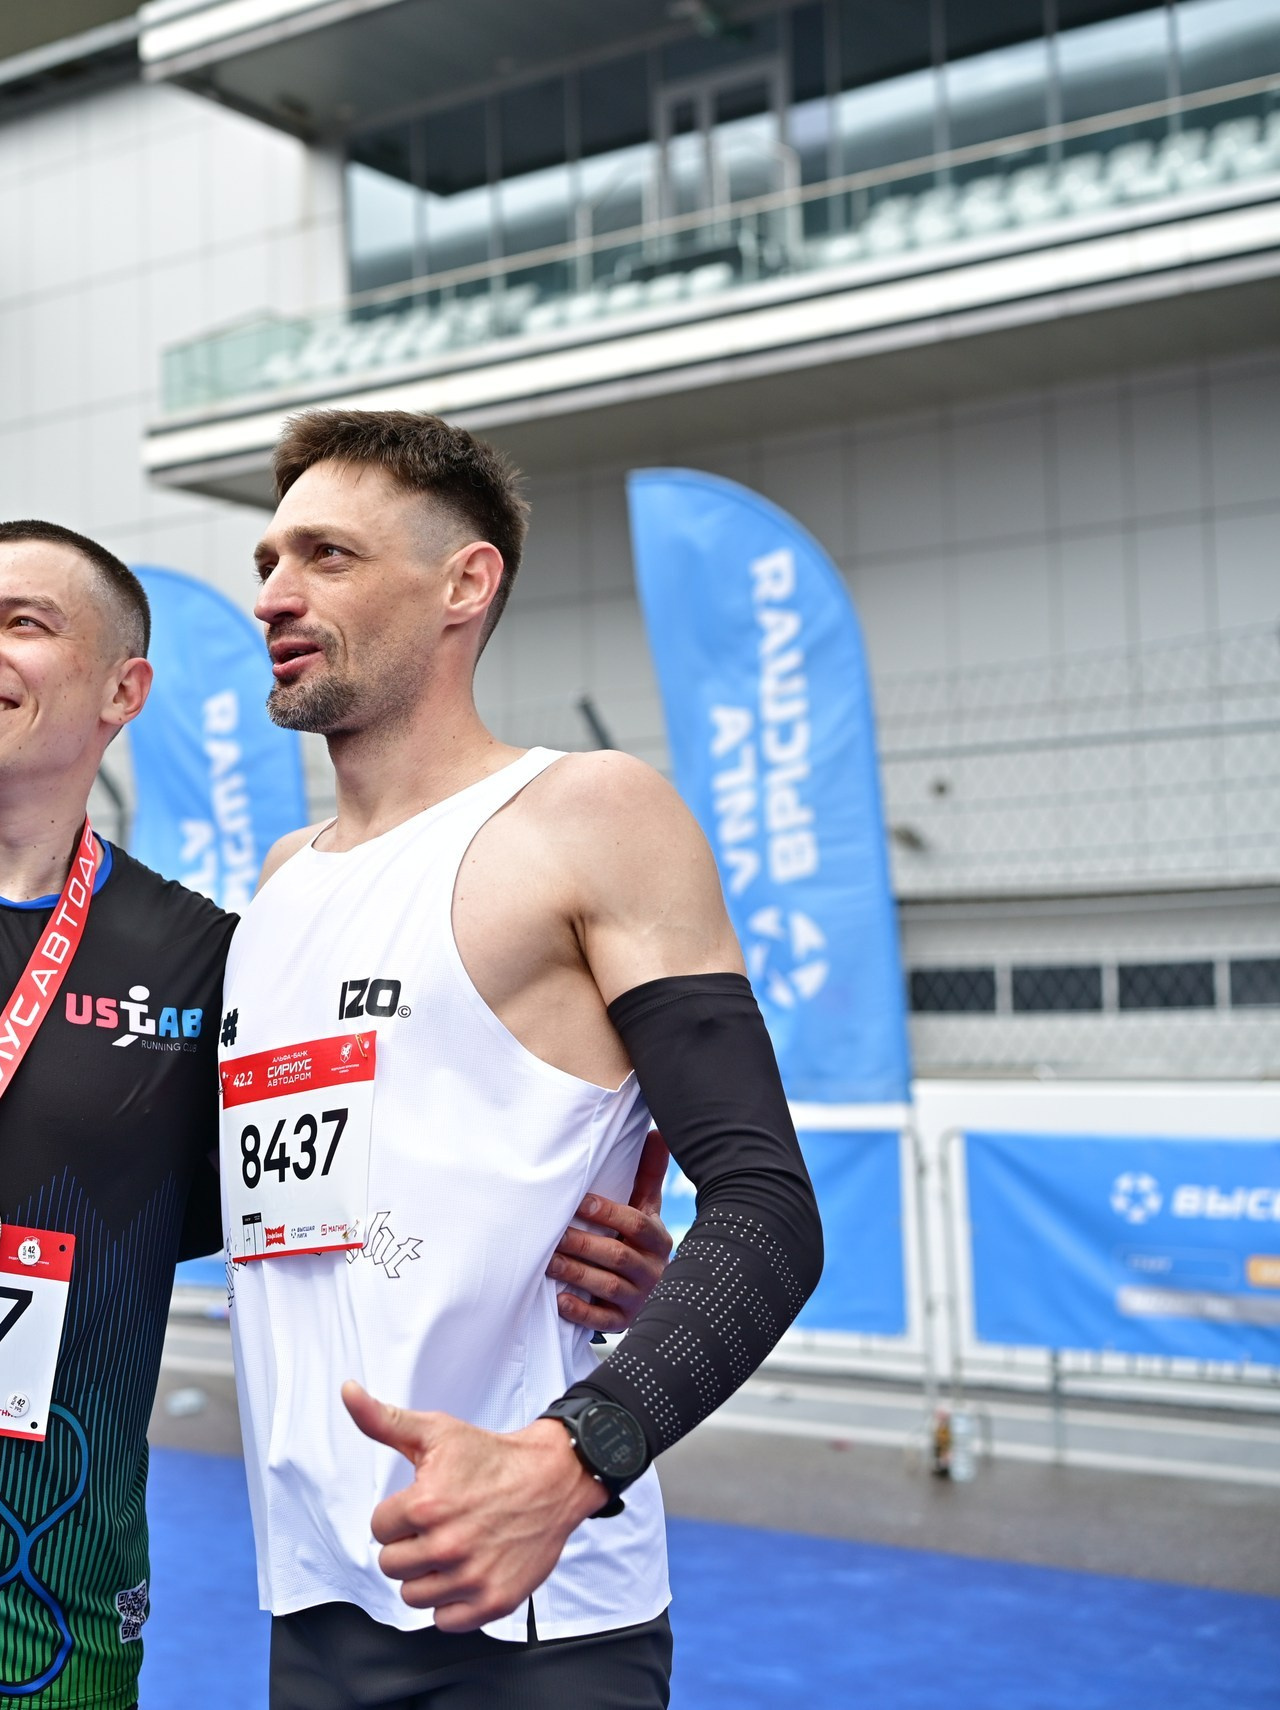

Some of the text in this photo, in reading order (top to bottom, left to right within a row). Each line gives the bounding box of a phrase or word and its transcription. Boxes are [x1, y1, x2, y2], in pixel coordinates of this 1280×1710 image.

[141, 1040, 181, 1052] RUNNING
[272, 1050, 309, 1063] АЛЬФА-БАНК
[267, 1058, 312, 1079] СИРИУС
[233, 1071, 253, 1088] 42.2
[267, 1072, 312, 1088] АВТОДРОМ
[241, 1108, 348, 1189] 8437
[1171, 1183, 1280, 1221] ВЫС
[28, 1245, 36, 1254] 42
[16, 1398, 26, 1408] 42
